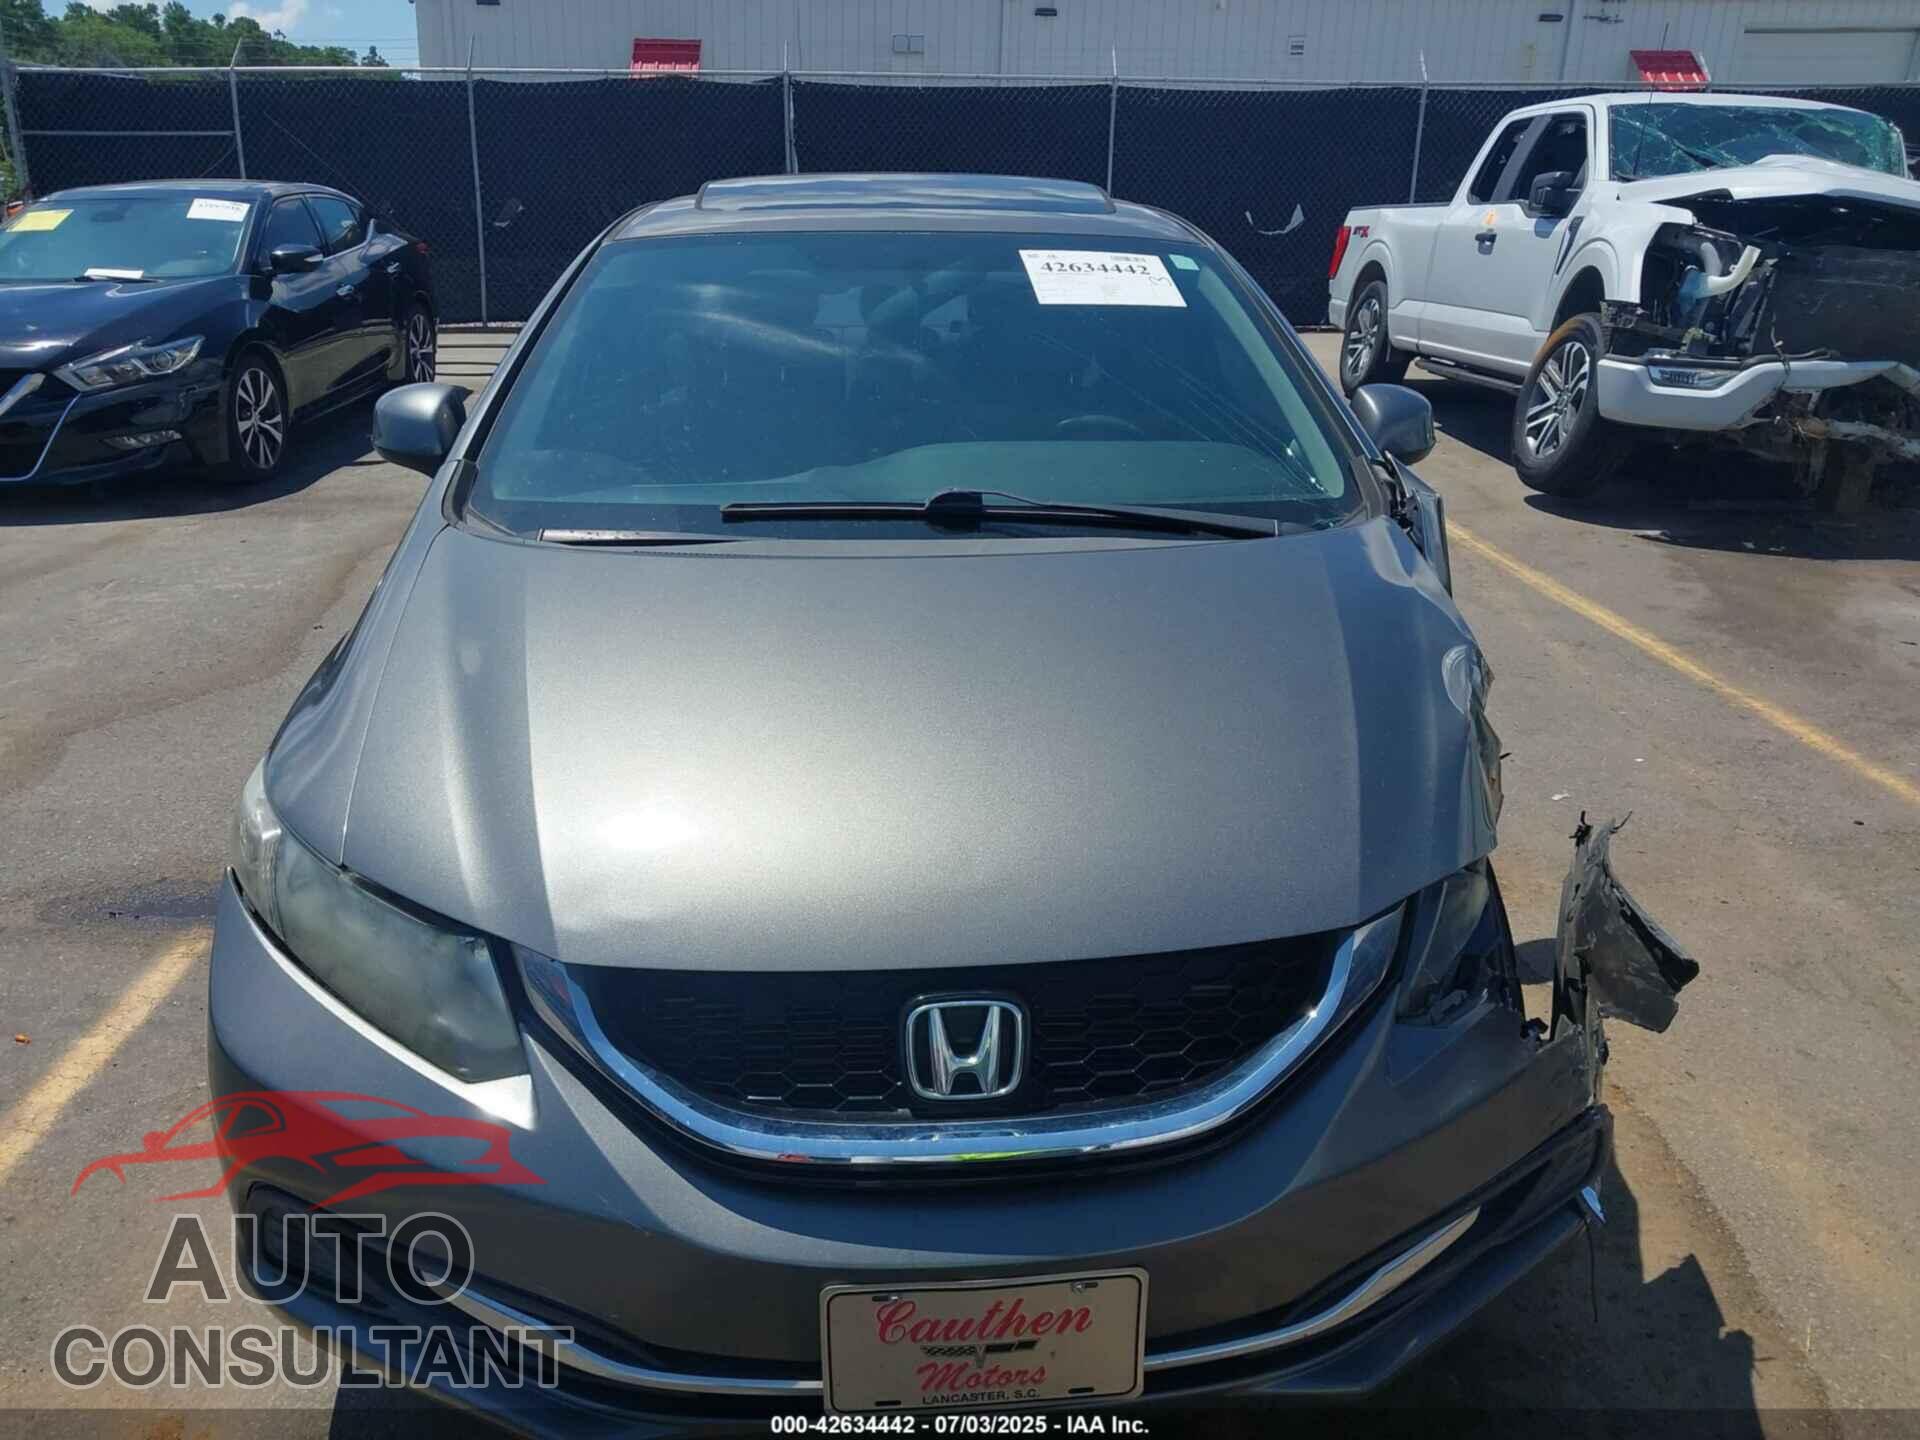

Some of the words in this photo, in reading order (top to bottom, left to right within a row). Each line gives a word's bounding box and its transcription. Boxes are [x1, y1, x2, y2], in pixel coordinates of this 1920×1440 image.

[1040, 261, 1151, 276] 42634442
[876, 1298, 1093, 1346] Cauthen
[917, 1359, 1047, 1393] Motors
[1014, 1387, 1041, 1399] S.C.
